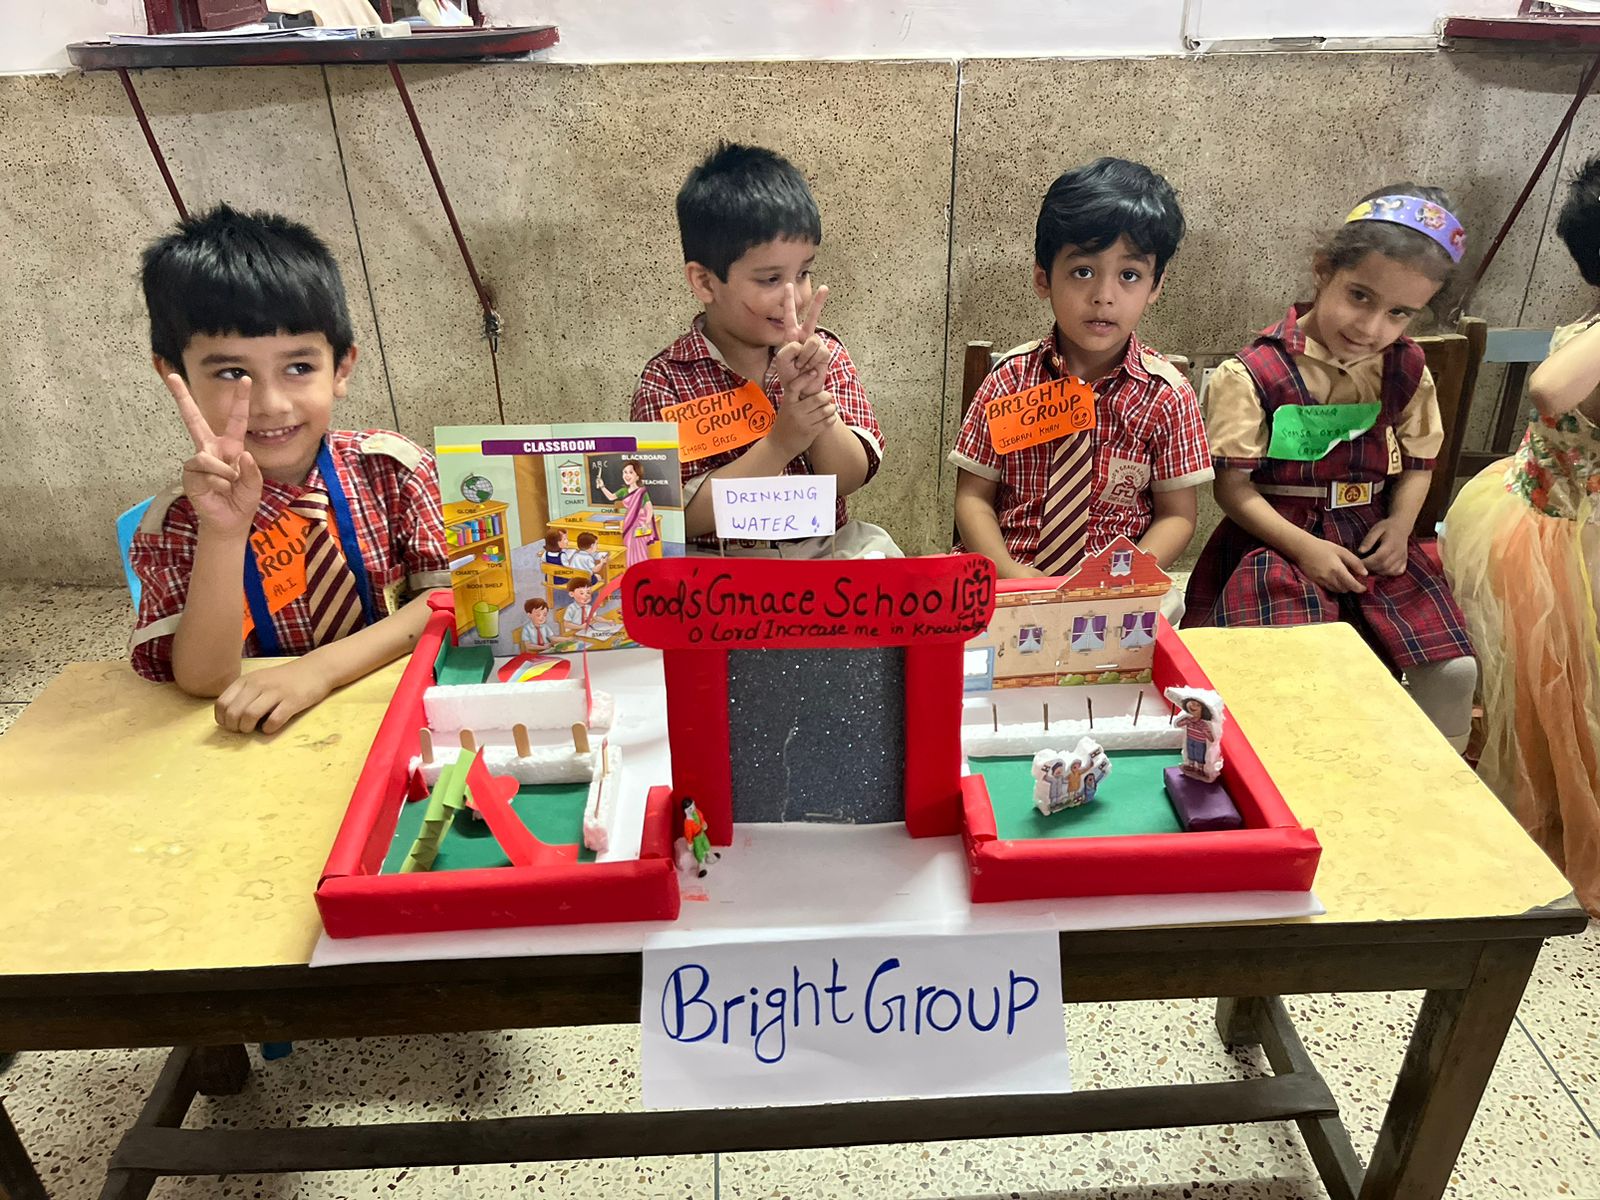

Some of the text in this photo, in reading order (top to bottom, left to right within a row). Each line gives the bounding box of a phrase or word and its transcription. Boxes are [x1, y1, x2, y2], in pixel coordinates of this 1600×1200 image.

[664, 391, 736, 424] BRIGHT
[988, 378, 1071, 420] BRIGHT
[1020, 394, 1082, 426] GROUP
[696, 402, 753, 435] GROUP
[523, 439, 596, 453] CLASSROOM
[726, 486, 818, 505] DRINKING
[732, 514, 799, 532] WATER
[633, 567, 702, 624] God's
[824, 576, 957, 617] School
[711, 620, 762, 642] Lord
[764, 619, 848, 640] Increase
[854, 624, 878, 637] me
[892, 623, 904, 634] in
[661, 957, 1039, 1063] Bright Group
